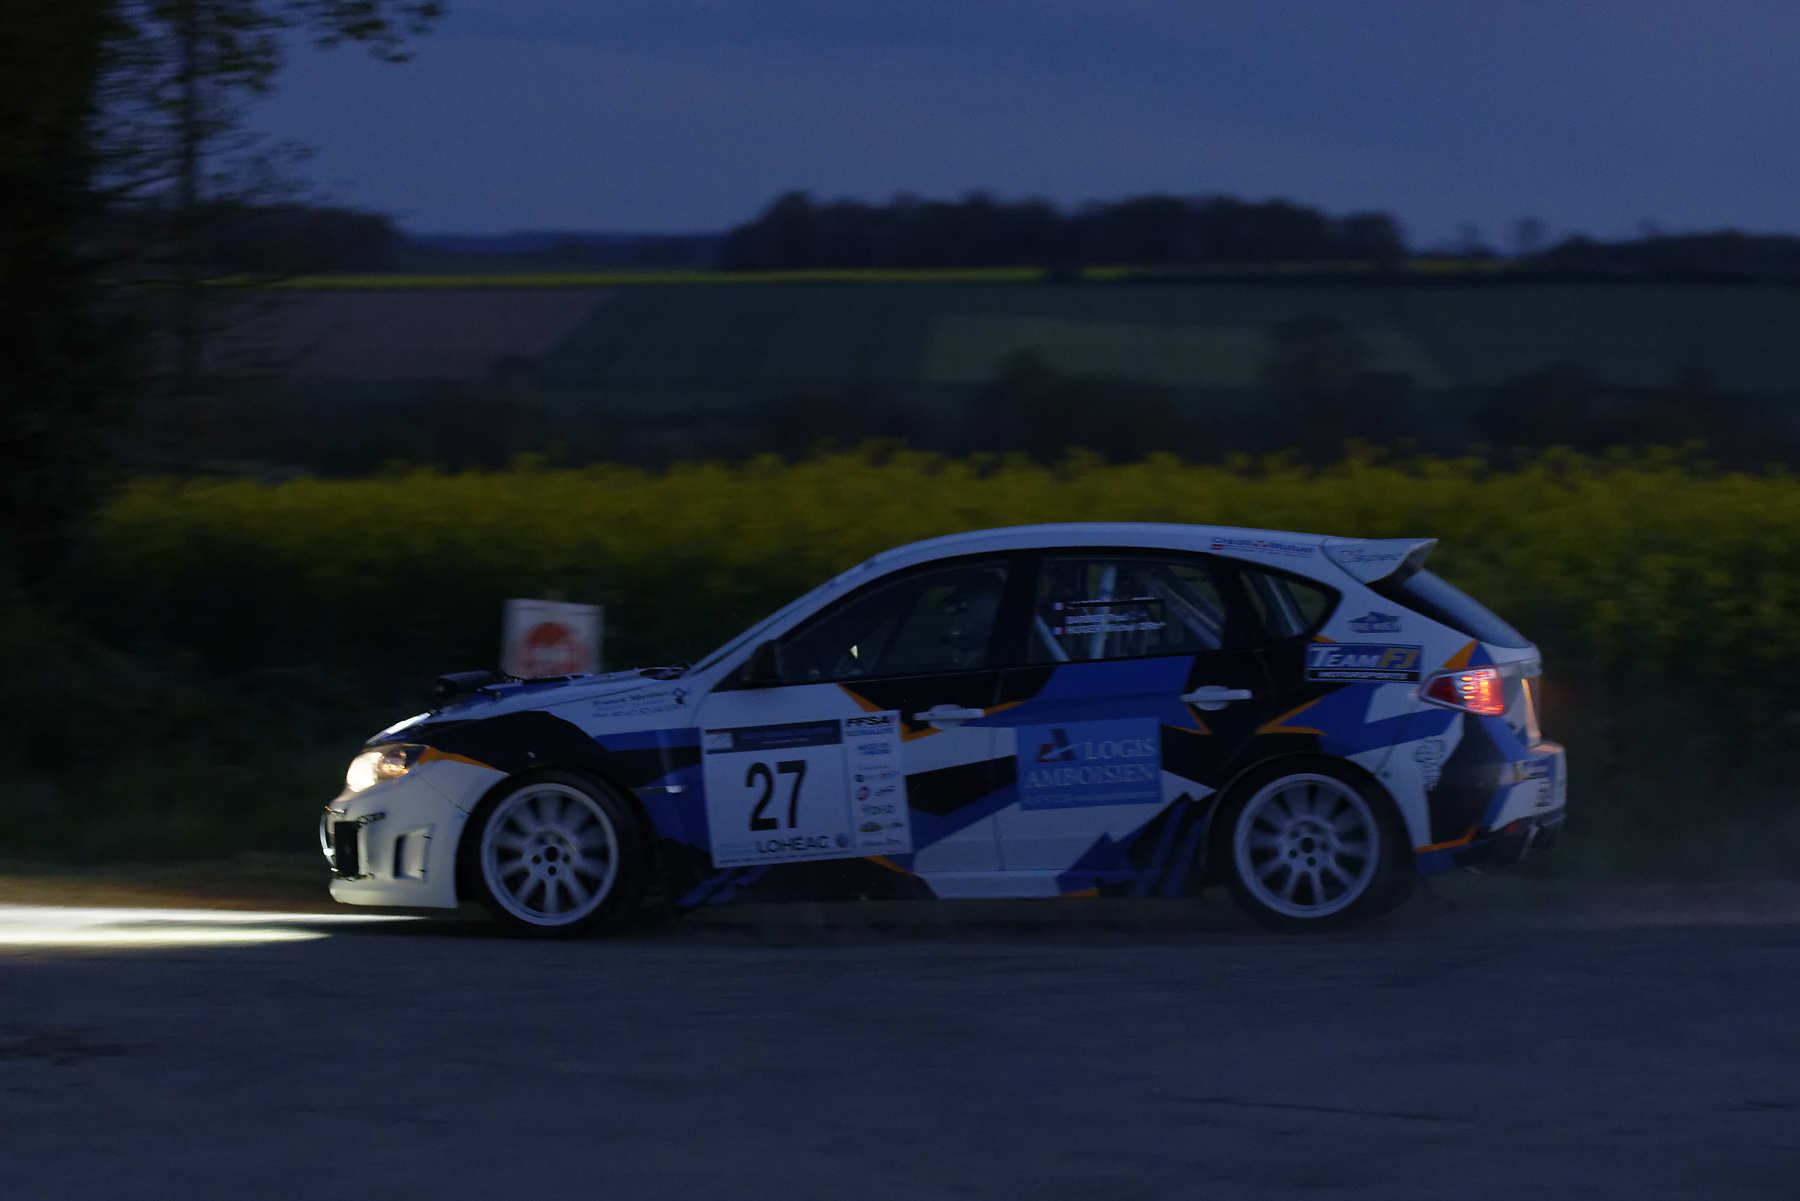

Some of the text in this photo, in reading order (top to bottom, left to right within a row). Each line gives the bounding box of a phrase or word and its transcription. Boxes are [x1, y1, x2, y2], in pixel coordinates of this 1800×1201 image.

[846, 716, 890, 726] FFSA
[1082, 738, 1156, 760] LOGIS
[1022, 763, 1156, 789] AMBOISIEN
[746, 760, 806, 831] 27
